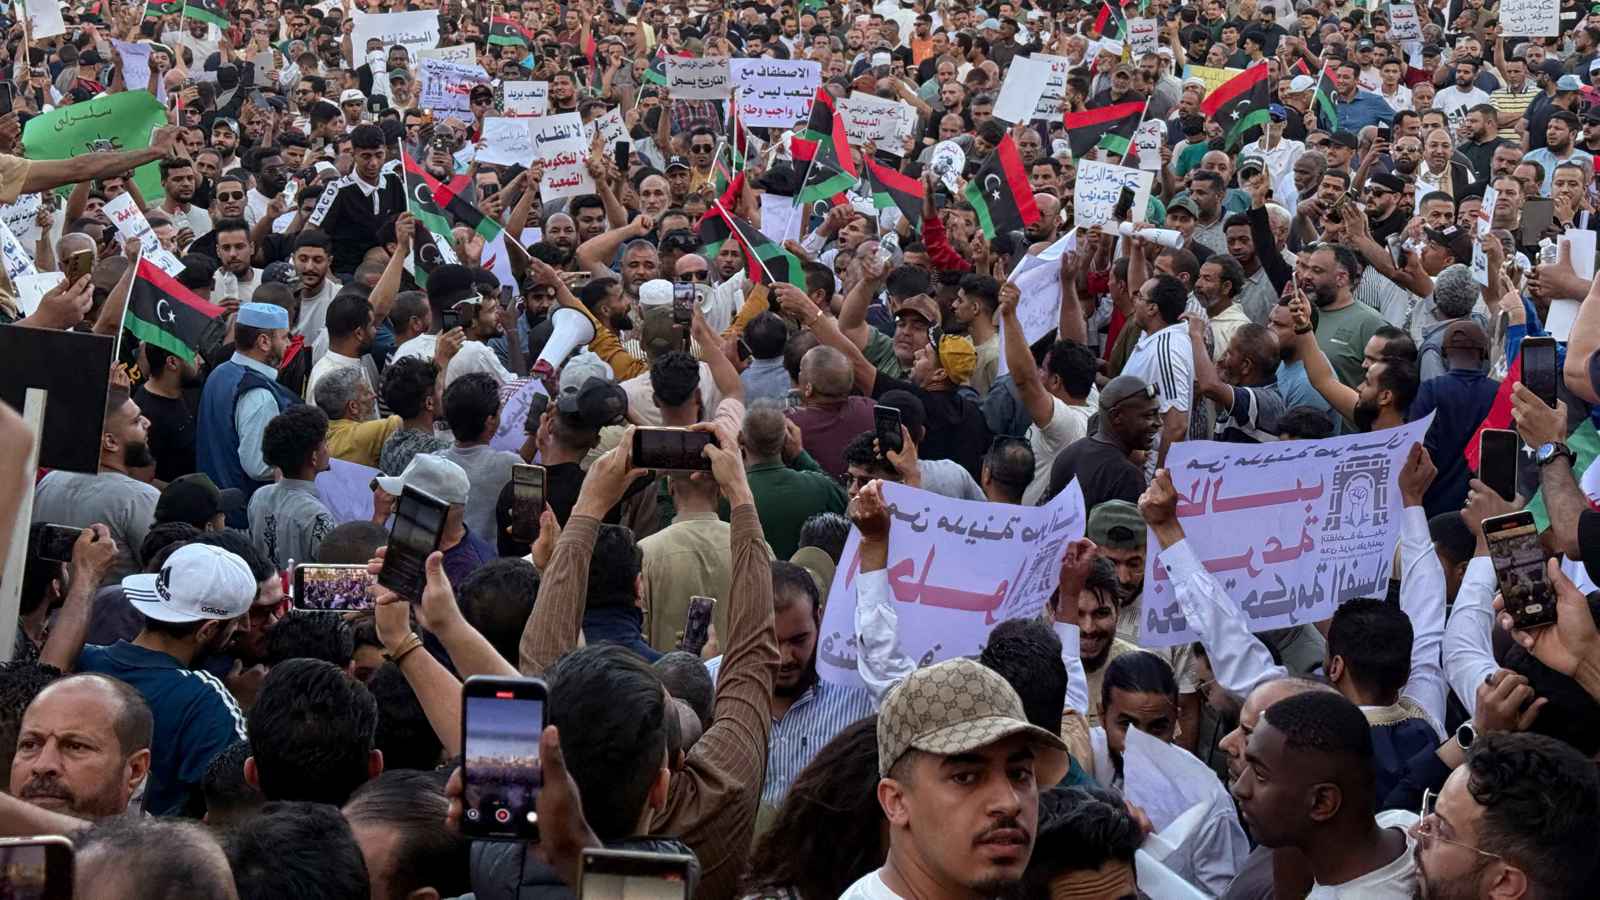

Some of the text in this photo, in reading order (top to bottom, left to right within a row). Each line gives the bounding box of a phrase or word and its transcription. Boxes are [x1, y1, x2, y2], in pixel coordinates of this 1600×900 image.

[741, 65, 809, 81] الاصطفاف مع
[535, 124, 571, 149] للظلم
